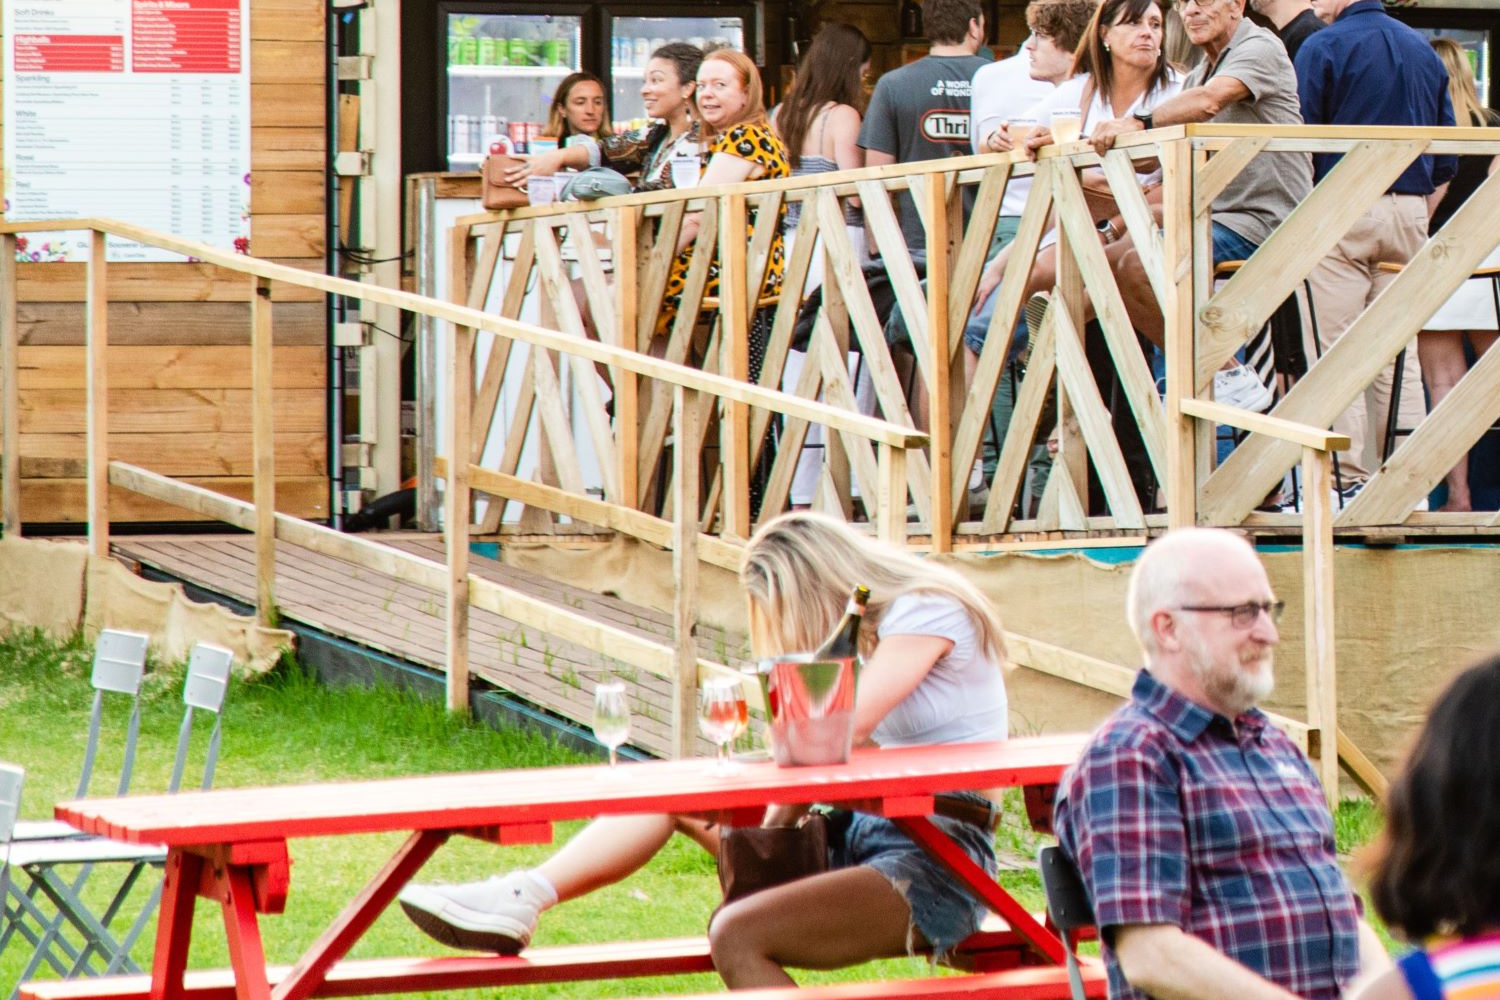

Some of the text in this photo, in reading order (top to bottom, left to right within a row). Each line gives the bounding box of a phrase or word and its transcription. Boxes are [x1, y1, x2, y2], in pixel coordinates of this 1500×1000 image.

[945, 80, 972, 88] WORL
[930, 87, 972, 97] OF WOND
[930, 117, 967, 134] Thri
